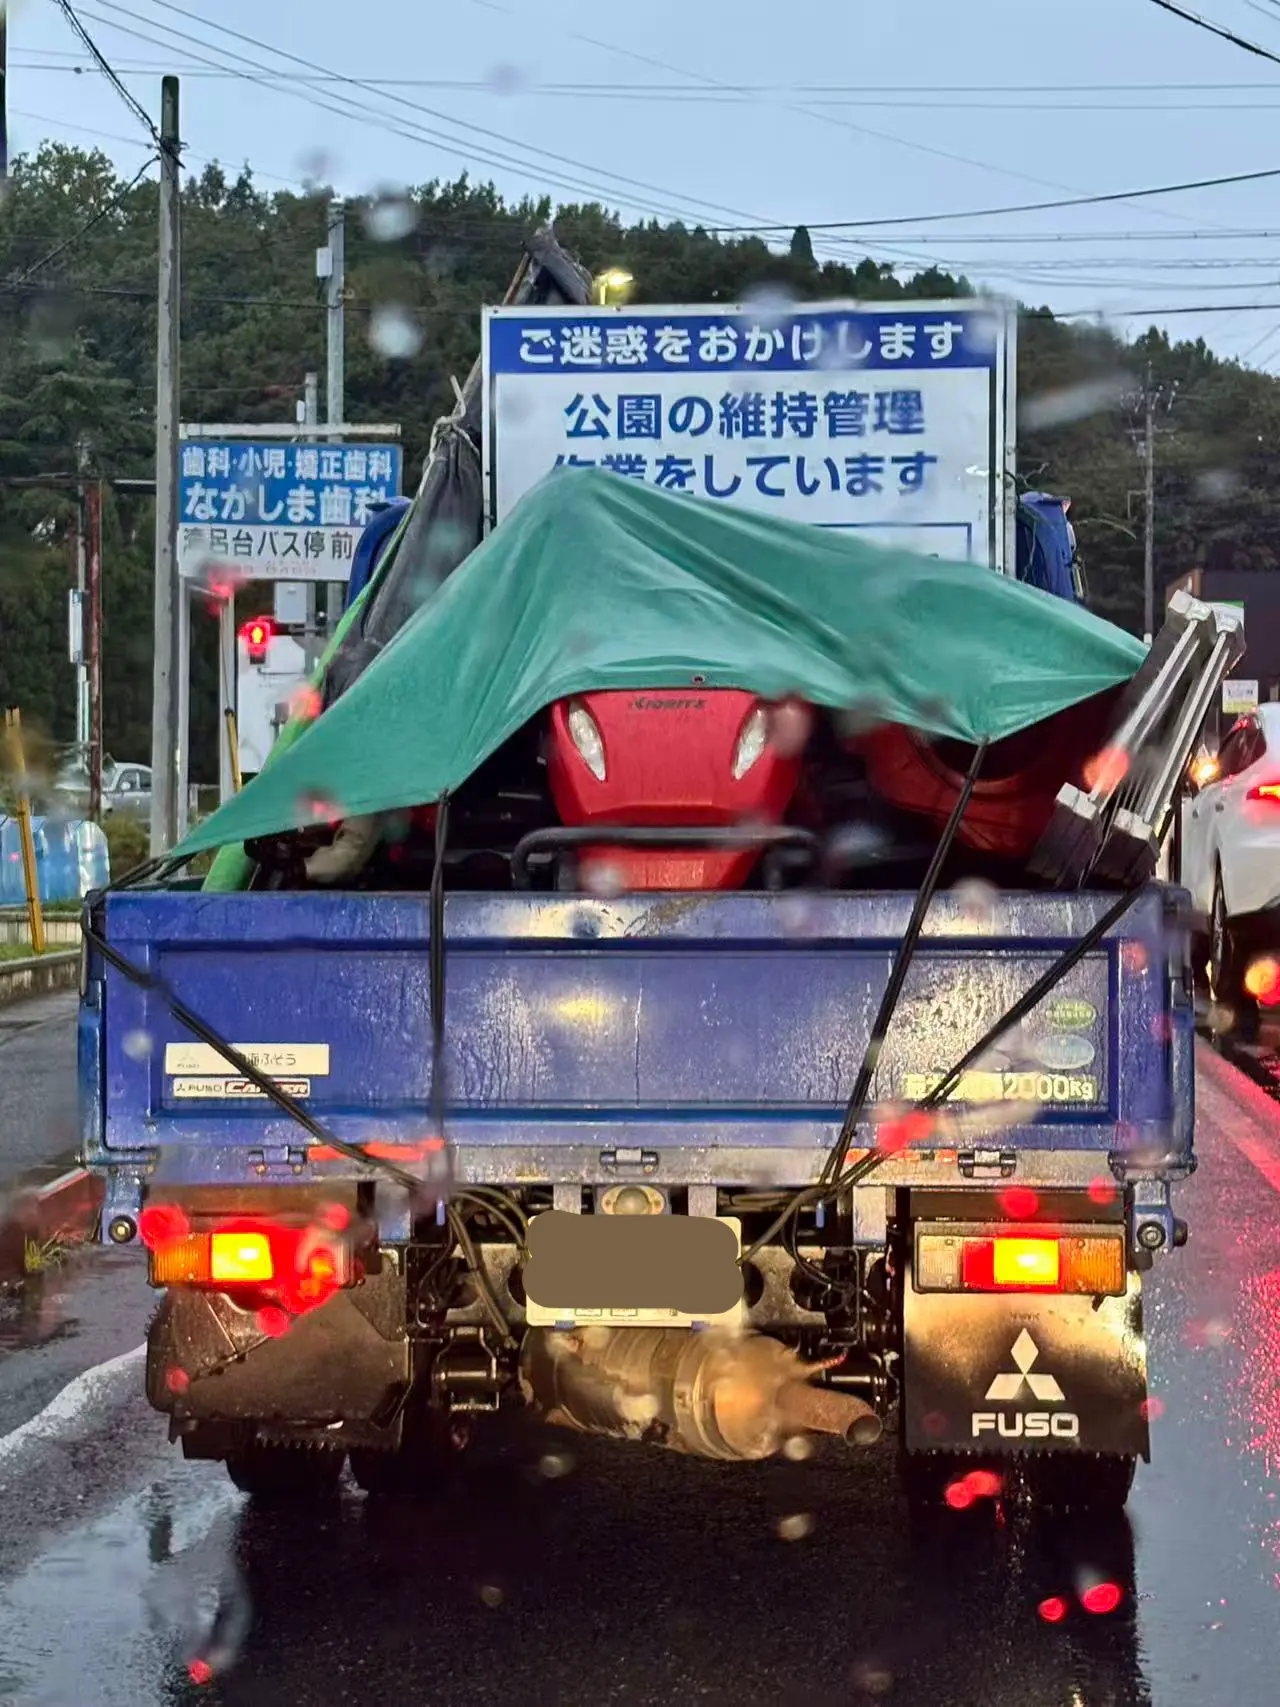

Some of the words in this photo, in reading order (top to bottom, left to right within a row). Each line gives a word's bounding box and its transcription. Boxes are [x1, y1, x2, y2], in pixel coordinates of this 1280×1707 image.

[519, 321, 963, 365] ご迷惑をおかけします
[563, 389, 926, 441] 公園の維持管理
[552, 452, 938, 498] 業をしています
[185, 481, 387, 526] なかしま歯科
[225, 1081, 308, 1094] CAER
[971, 1412, 1079, 1437] FUSO
